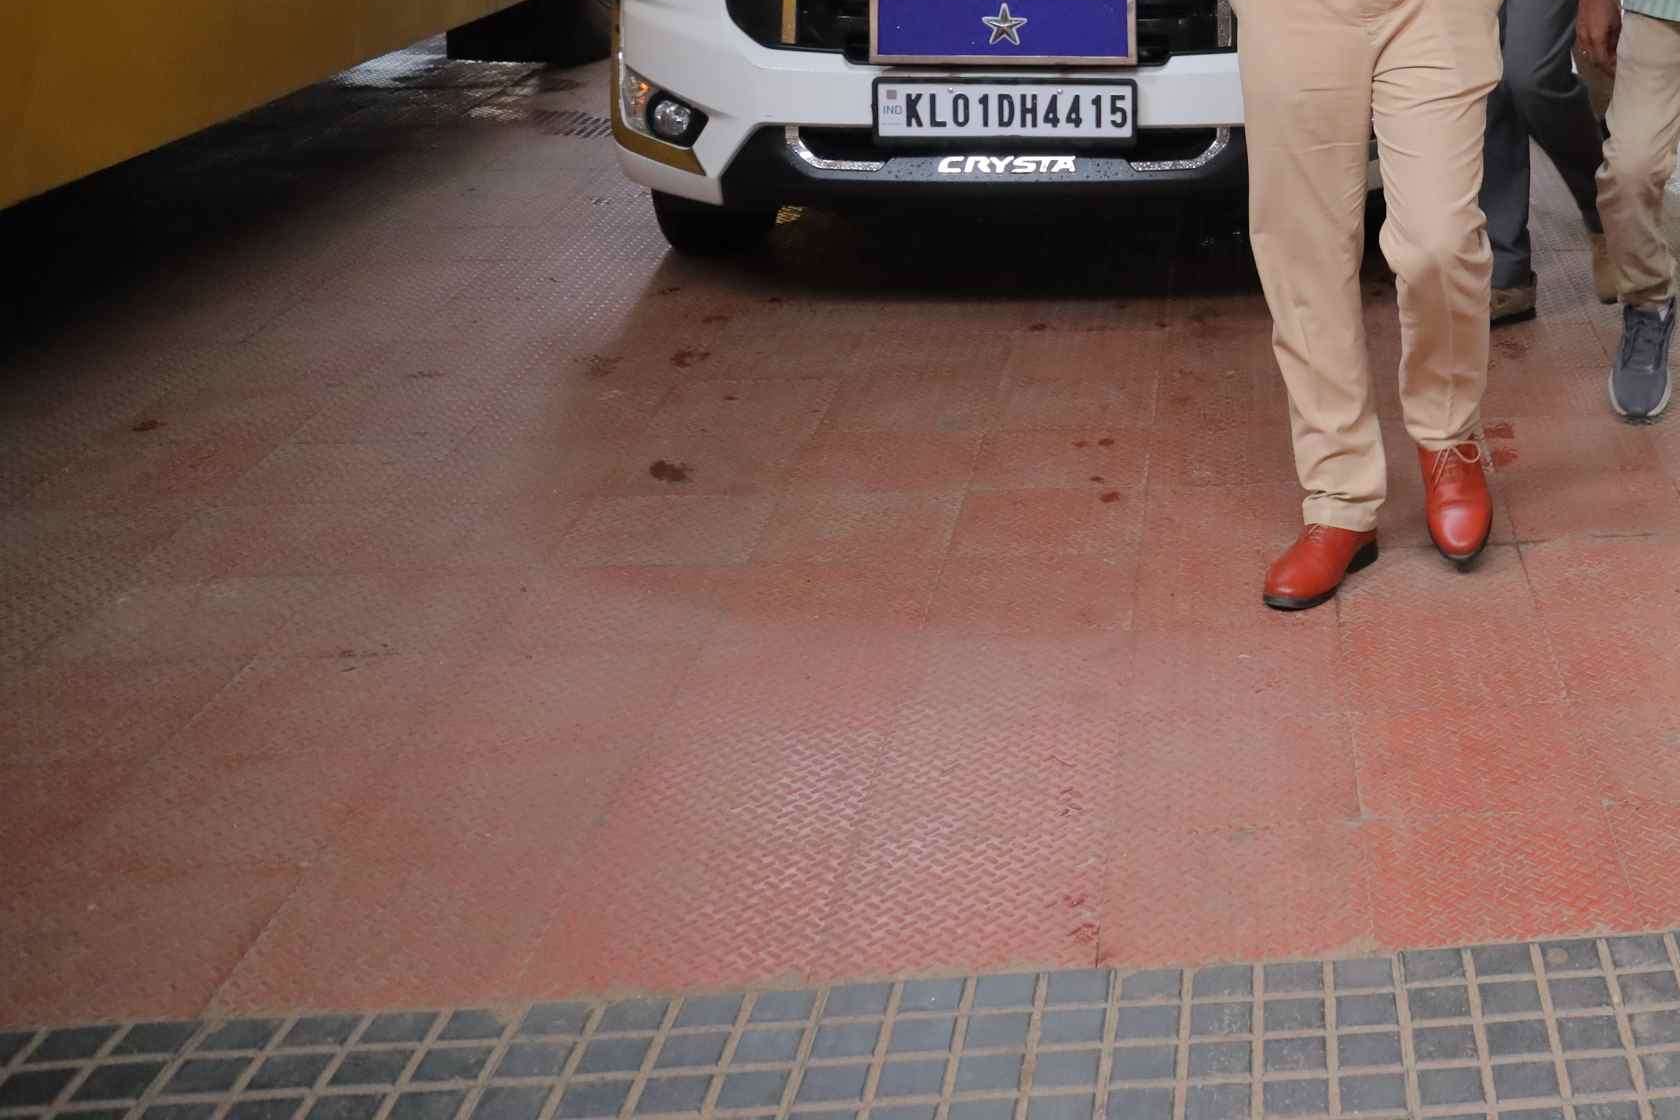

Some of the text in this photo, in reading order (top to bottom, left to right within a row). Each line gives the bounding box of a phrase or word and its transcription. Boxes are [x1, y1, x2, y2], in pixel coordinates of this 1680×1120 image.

[882, 92, 1128, 129] IND KL01DH4415
[936, 154, 1077, 174] CRYSTA
